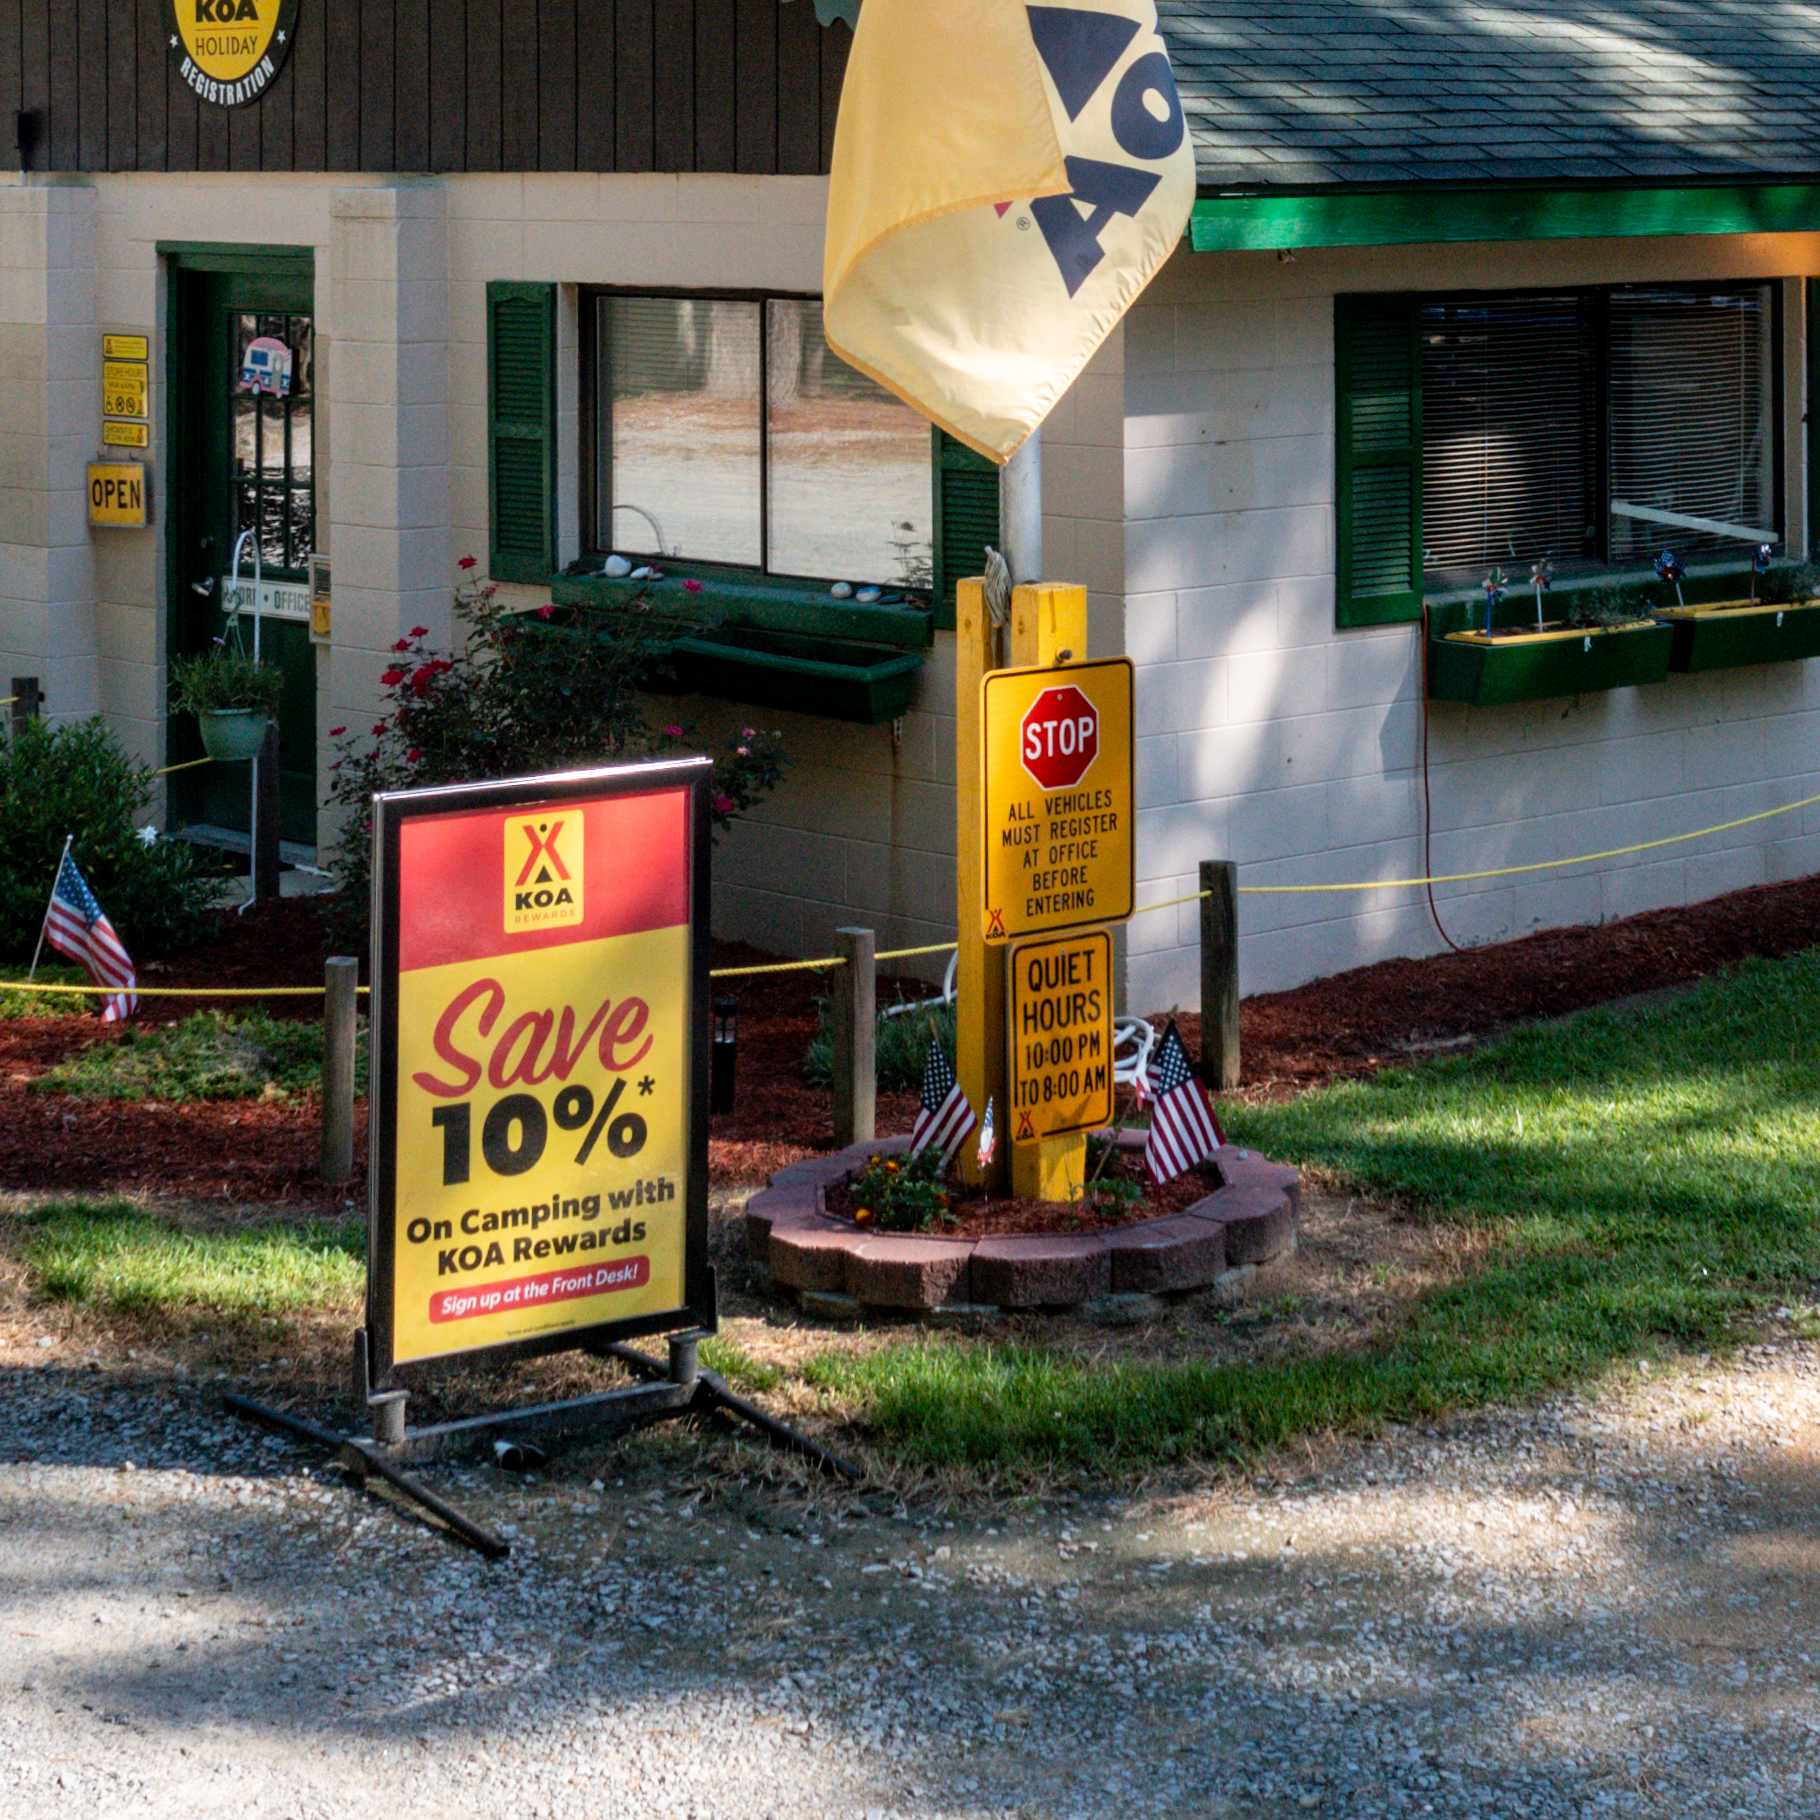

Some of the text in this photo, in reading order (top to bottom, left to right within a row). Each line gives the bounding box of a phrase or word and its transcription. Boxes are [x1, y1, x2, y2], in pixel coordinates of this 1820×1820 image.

[196, 36, 258, 56] HOLIDAY
[180, 55, 275, 105] REGISTRATION
[106, 366, 144, 378] STORE HOURS
[92, 479, 141, 509] OPEN
[274, 590, 310, 612] OFFICE
[1025, 716, 1094, 760] STOP
[1008, 789, 1113, 822] ALL VEHICLES
[1002, 812, 1118, 847] MUST REGISTER
[1023, 839, 1098, 869] AT OFFICE
[1032, 865, 1088, 892] BEFORE
[515, 887, 574, 911] KOA
[515, 909, 575, 924] REWARDS
[1026, 889, 1095, 917] ENTERING
[1028, 949, 1095, 992] QUIET
[1023, 990, 1101, 1035] HOURS
[412, 978, 654, 1098] Save
[1026, 1031, 1100, 1070] 10:00 PM
[1020, 1064, 1105, 1107] TO 8:00 AM
[407, 1177, 675, 1244] On Camping with
[438, 1218, 646, 1276] KOA Rewards
[441, 1265, 638, 1316] Sign up at the Front Desk!
